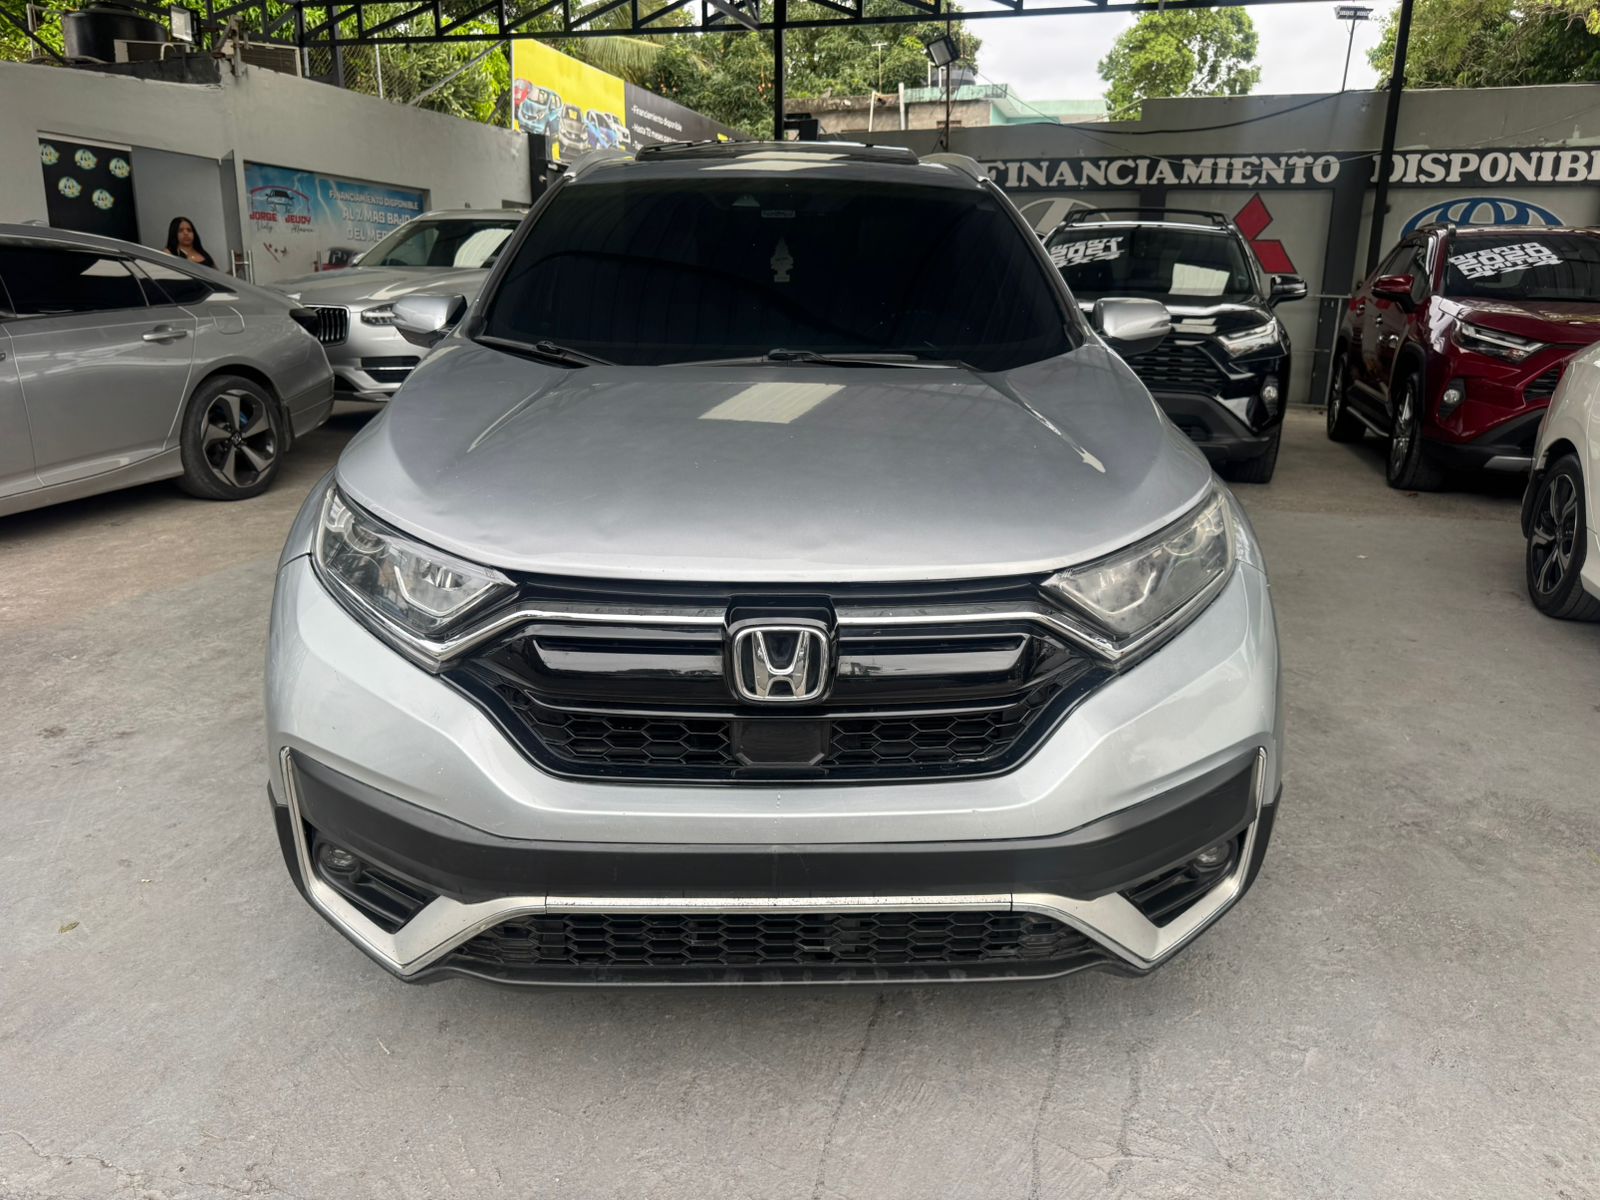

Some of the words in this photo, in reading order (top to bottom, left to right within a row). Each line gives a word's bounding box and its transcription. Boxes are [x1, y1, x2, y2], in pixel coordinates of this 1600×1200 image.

[979, 154, 1340, 188] FINANCIAMIENTO
[329, 190, 383, 205] FINANCIAMIENTO
[384, 198, 418, 210] DISPONIBLE
[249, 211, 277, 222] JORGE
[347, 226, 364, 240] DEL
[1051, 241, 1118, 260] 2021
[1448, 242, 1541, 264] OFERTA
[1457, 246, 1553, 271] 2020
[1462, 254, 1559, 275] LIMITED
